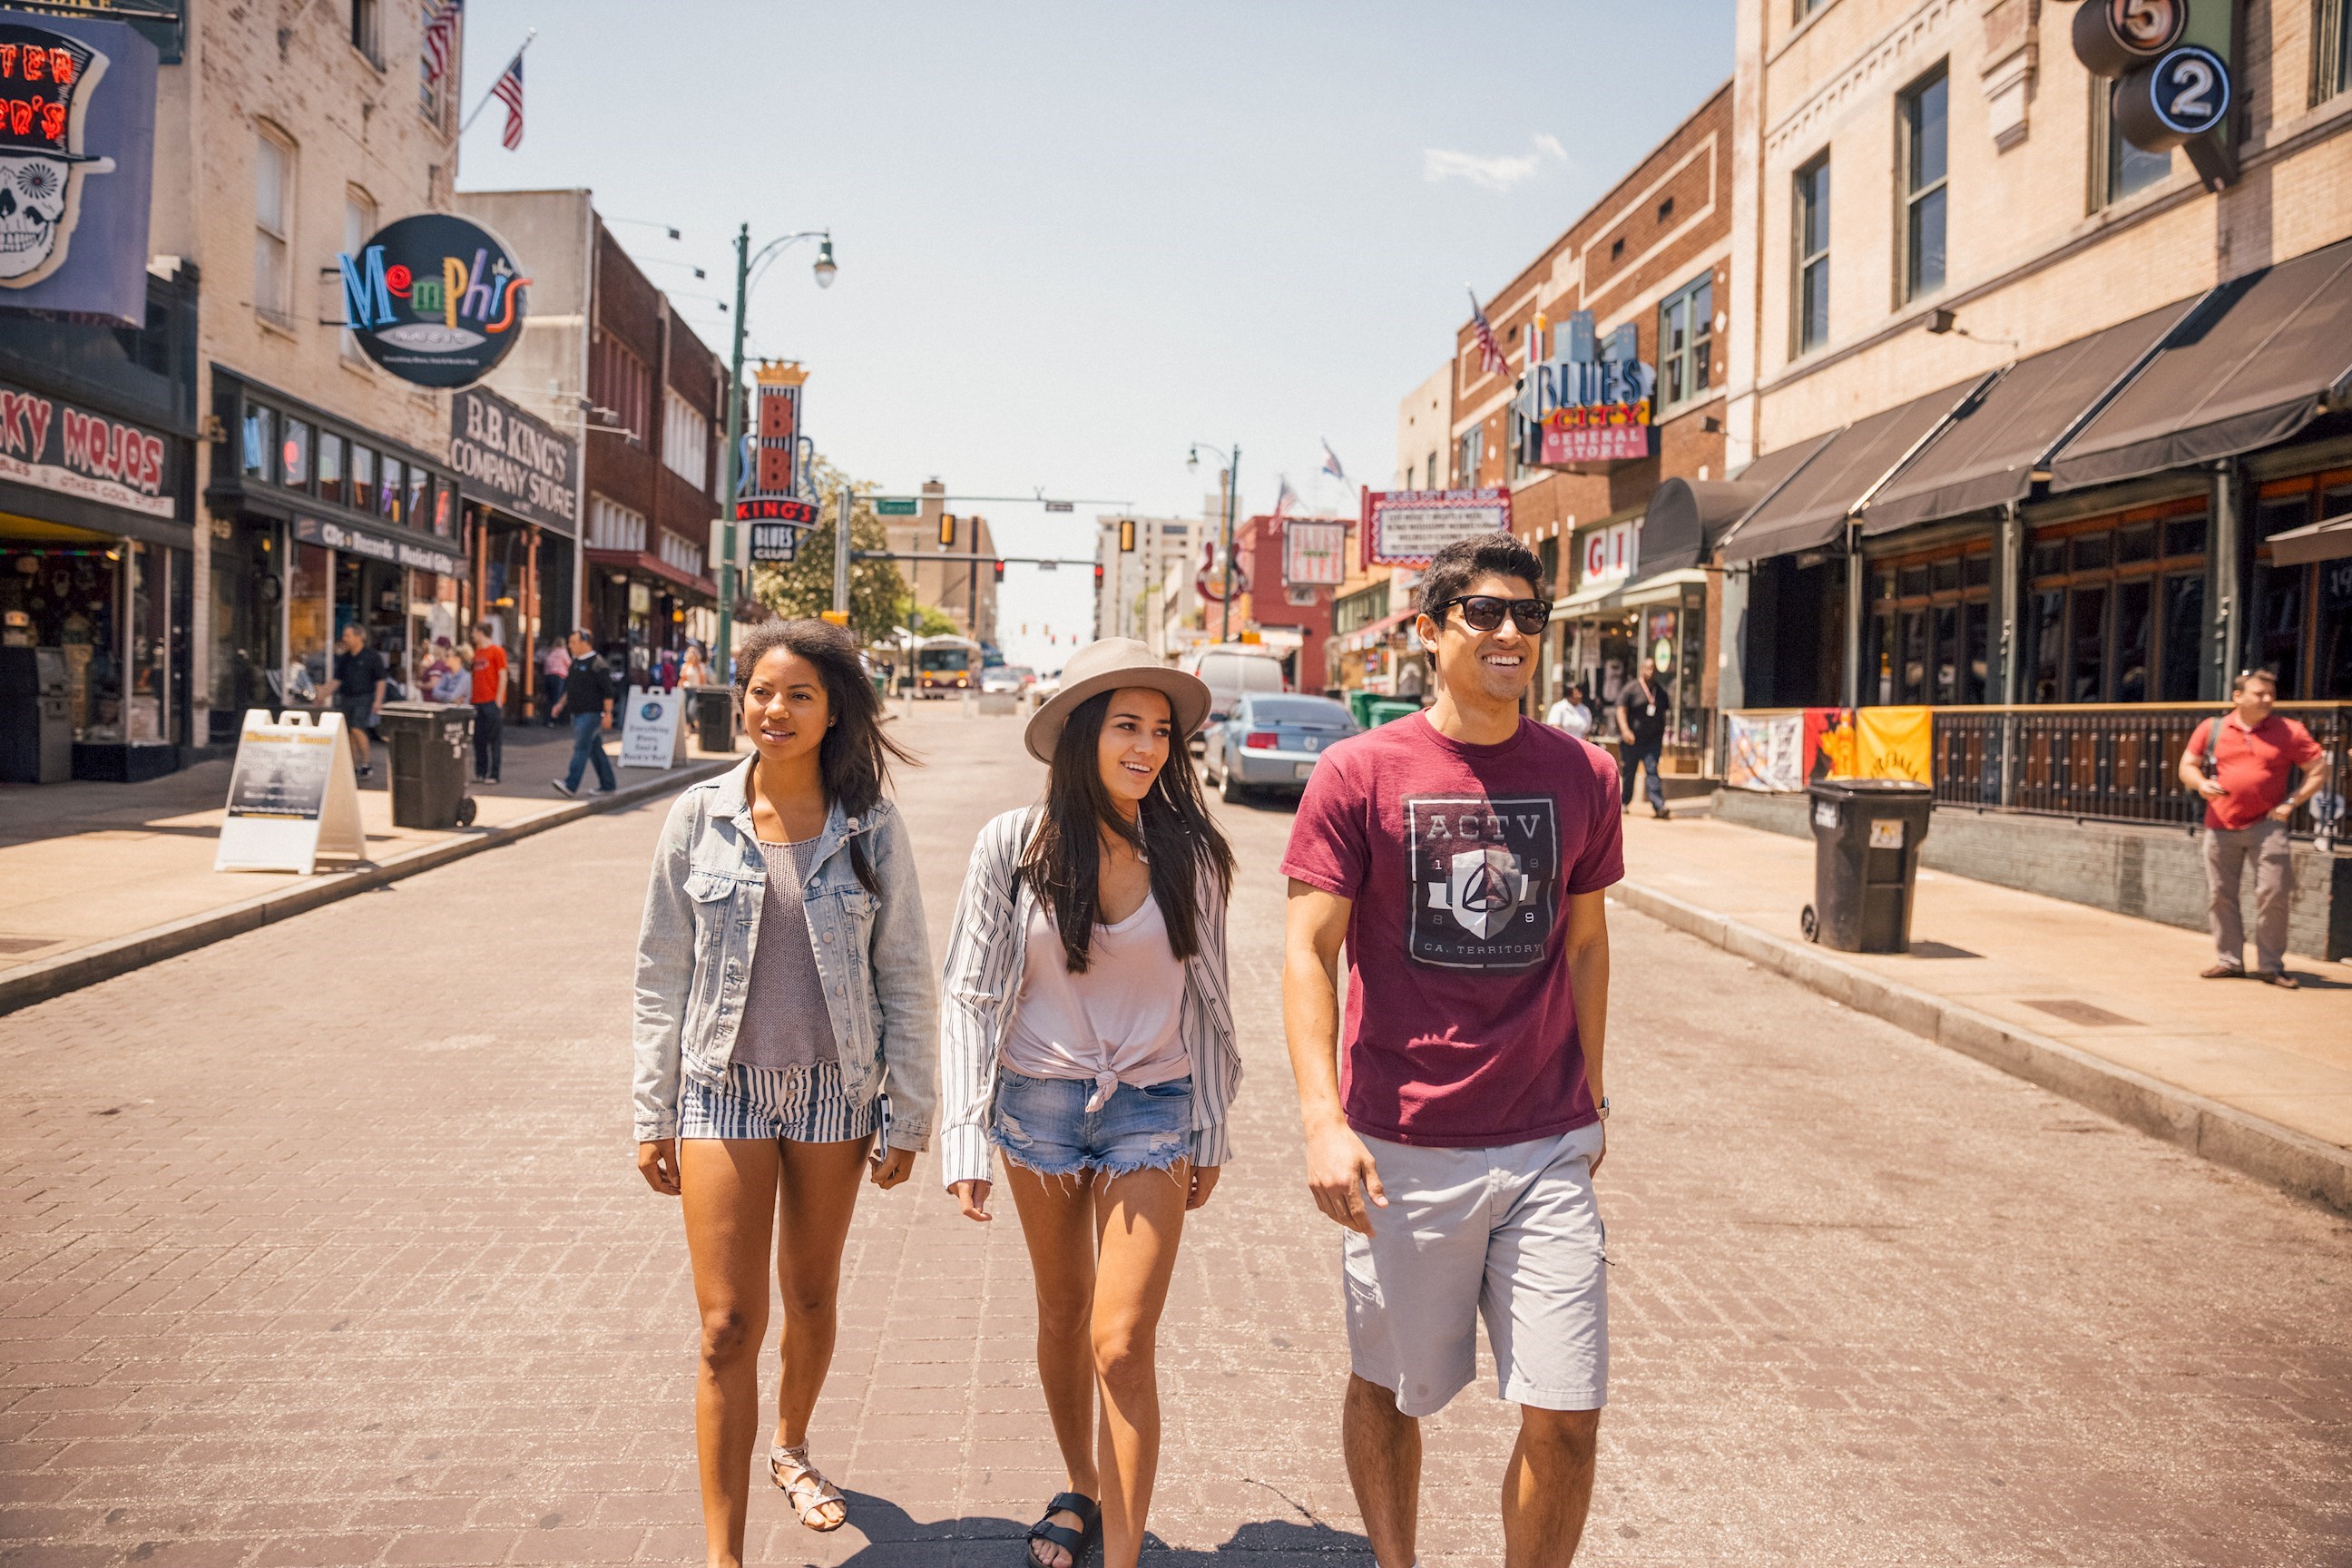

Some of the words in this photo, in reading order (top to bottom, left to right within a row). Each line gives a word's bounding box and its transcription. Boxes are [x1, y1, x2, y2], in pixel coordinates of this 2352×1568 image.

[2126, 0, 2169, 40] 5
[2171, 59, 2213, 116] 2
[335, 244, 534, 333] Memphis
[1538, 358, 1642, 422] BLUES
[1553, 404, 1645, 431] CITY
[0, 388, 52, 464] KY
[63, 407, 164, 496] MOJOS
[466, 393, 505, 453] B.B.
[506, 416, 567, 482] KING'S
[1548, 428, 1640, 447] GENERAL
[1563, 443, 1626, 459] STORE
[451, 437, 528, 498] COMPANY
[529, 472, 576, 521] STORE
[735, 502, 812, 524] KING'S
[1589, 527, 1641, 577] GI
[1426, 814, 1541, 840] ACTV
[1435, 859, 1443, 870] 1
[1529, 858, 1539, 868] 9
[1433, 914, 1443, 925] 8
[1524, 912, 1534, 923] 9
[1425, 942, 1449, 954] CA.
[1457, 944, 1542, 956] TERRITORY
